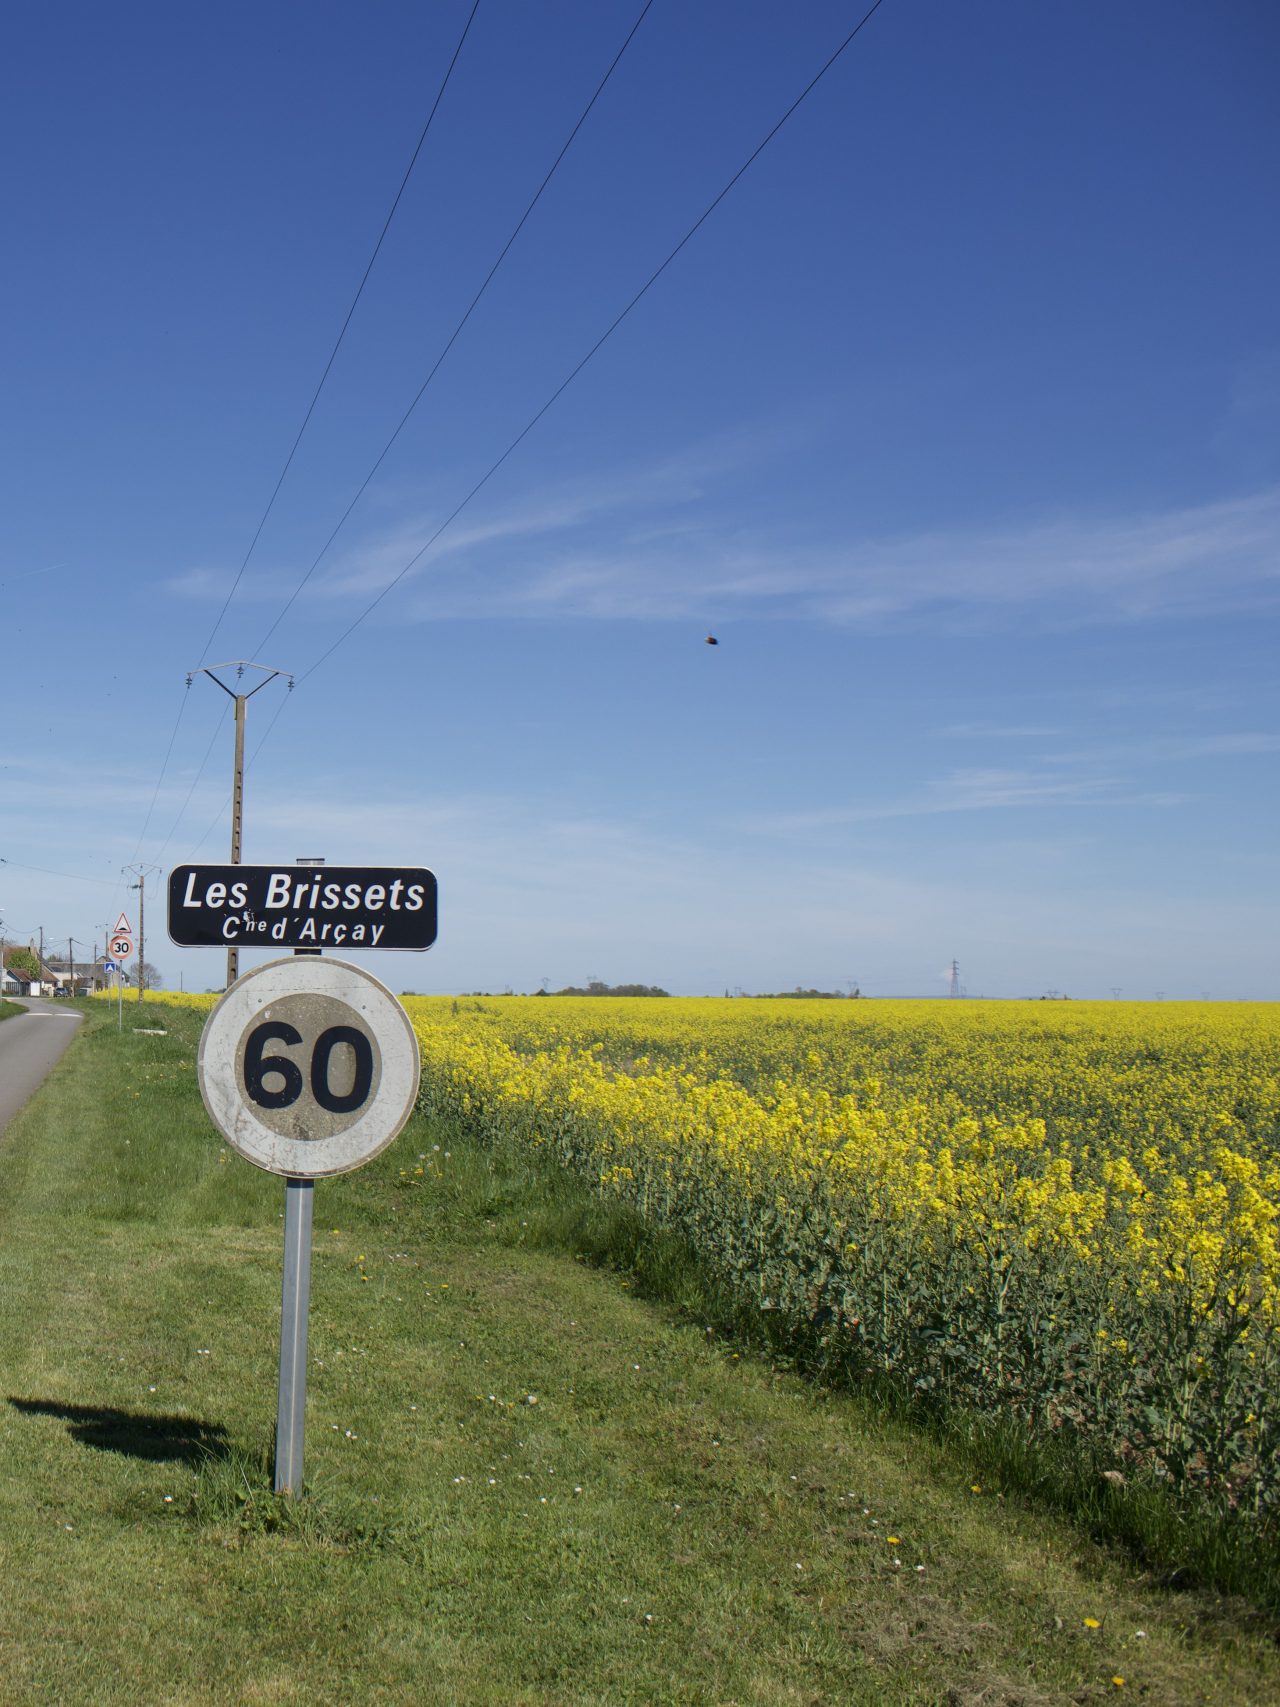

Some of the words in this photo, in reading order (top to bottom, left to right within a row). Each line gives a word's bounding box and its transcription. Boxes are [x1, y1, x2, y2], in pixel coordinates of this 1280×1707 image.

[182, 872, 248, 908] Les
[264, 873, 425, 910] Brissets
[114, 942, 129, 953] 30
[243, 1021, 373, 1114] 60
